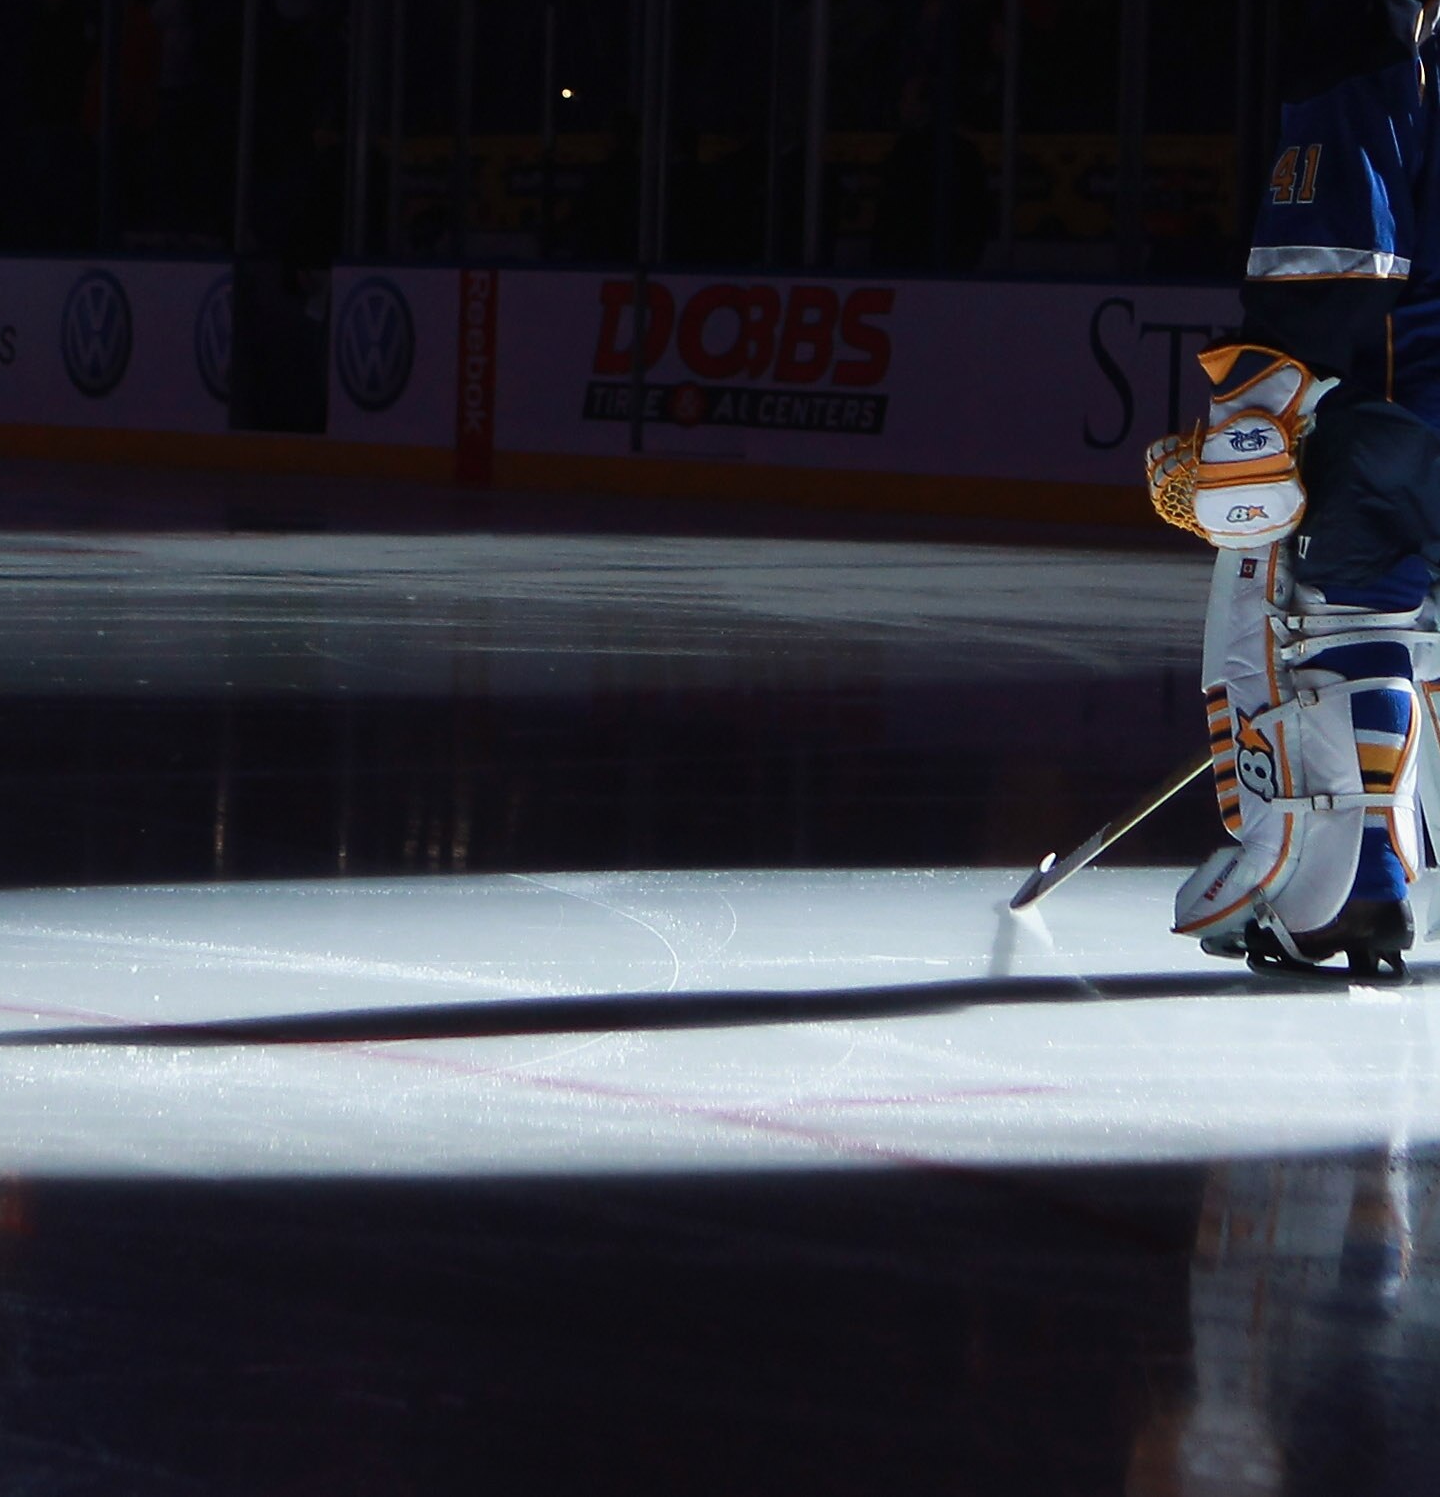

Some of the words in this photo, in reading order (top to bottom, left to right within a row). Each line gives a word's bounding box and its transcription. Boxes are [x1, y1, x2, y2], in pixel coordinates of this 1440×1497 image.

[1269, 143, 1323, 205] 41
[462, 269, 491, 435] Reebok
[591, 278, 897, 387] DOBBS
[759, 395, 878, 428] CENTERS
